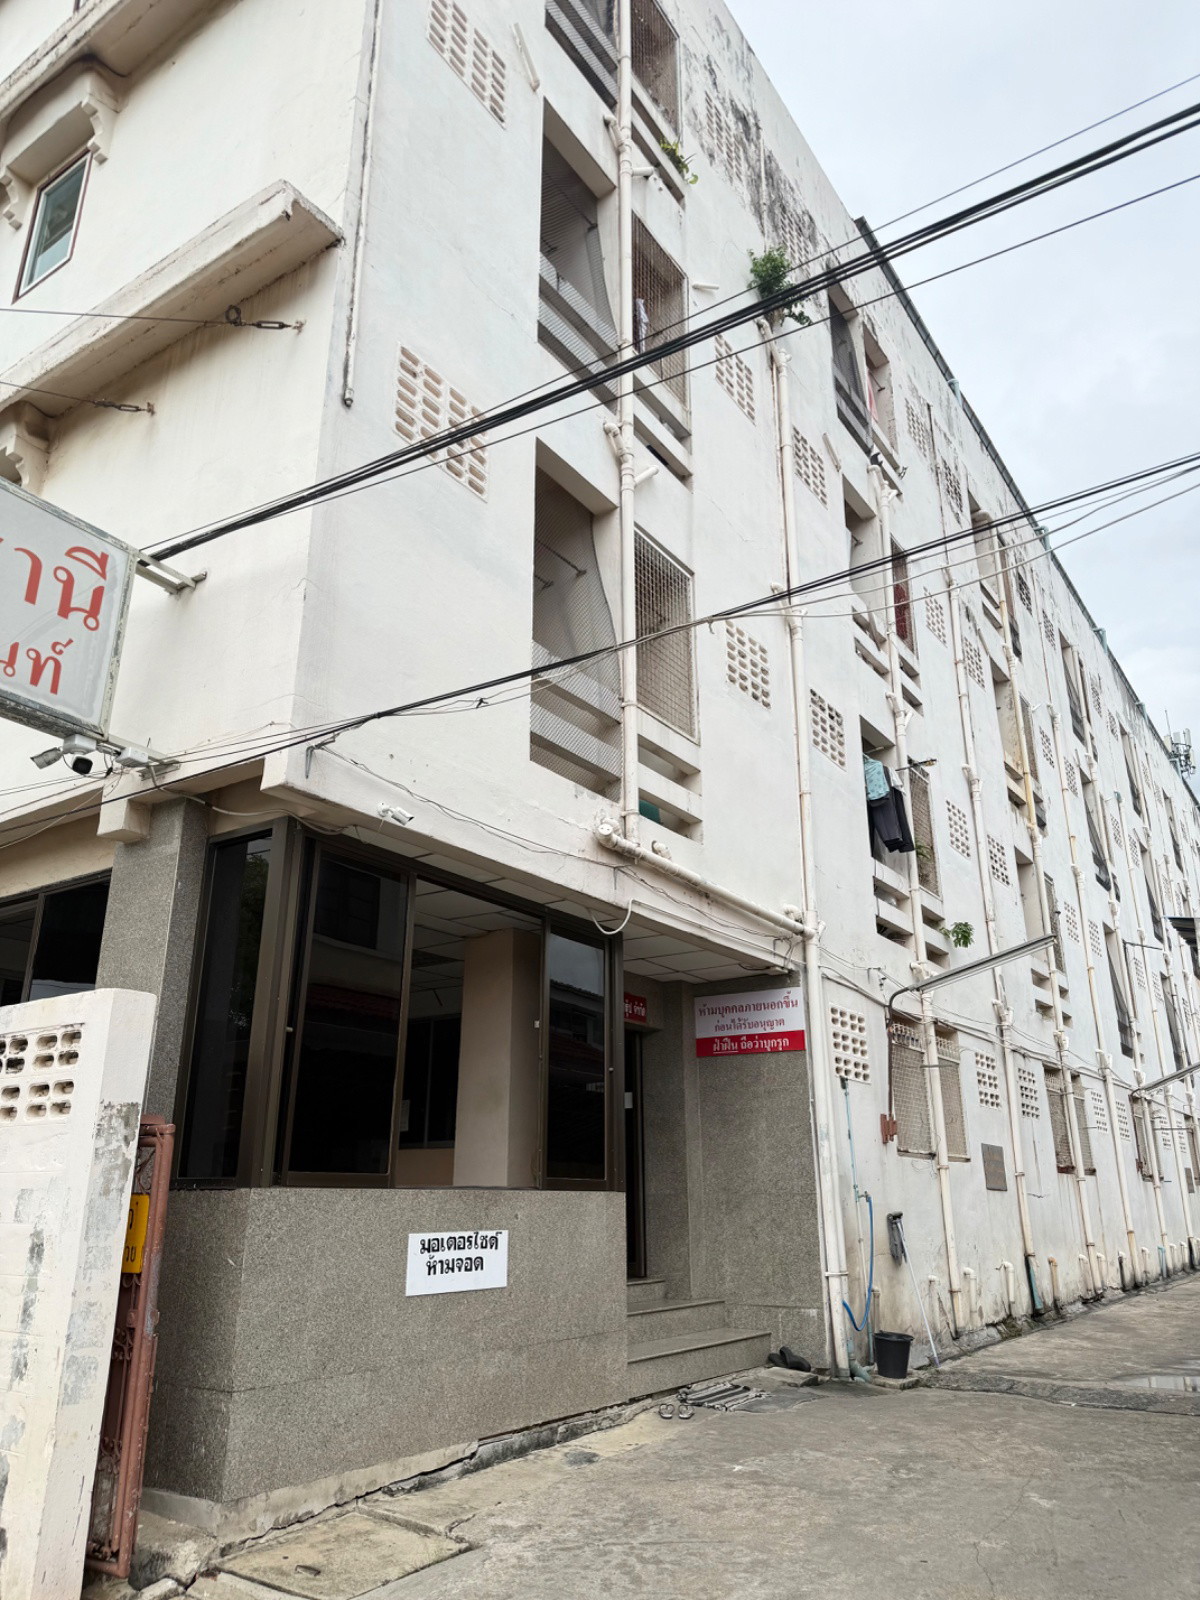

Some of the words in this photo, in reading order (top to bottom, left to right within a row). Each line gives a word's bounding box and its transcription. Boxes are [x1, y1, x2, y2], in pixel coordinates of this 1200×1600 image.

[0, 536, 110, 632] านี
[698, 990, 799, 1019] ห้ามบุคคลภายนอกขึ้น
[714, 1017, 785, 1033] ก่อนได้รับอนุญาต
[740, 1035, 789, 1052] ถือว่าบุกรุก
[426, 1254, 485, 1276] ห้ามจอด
